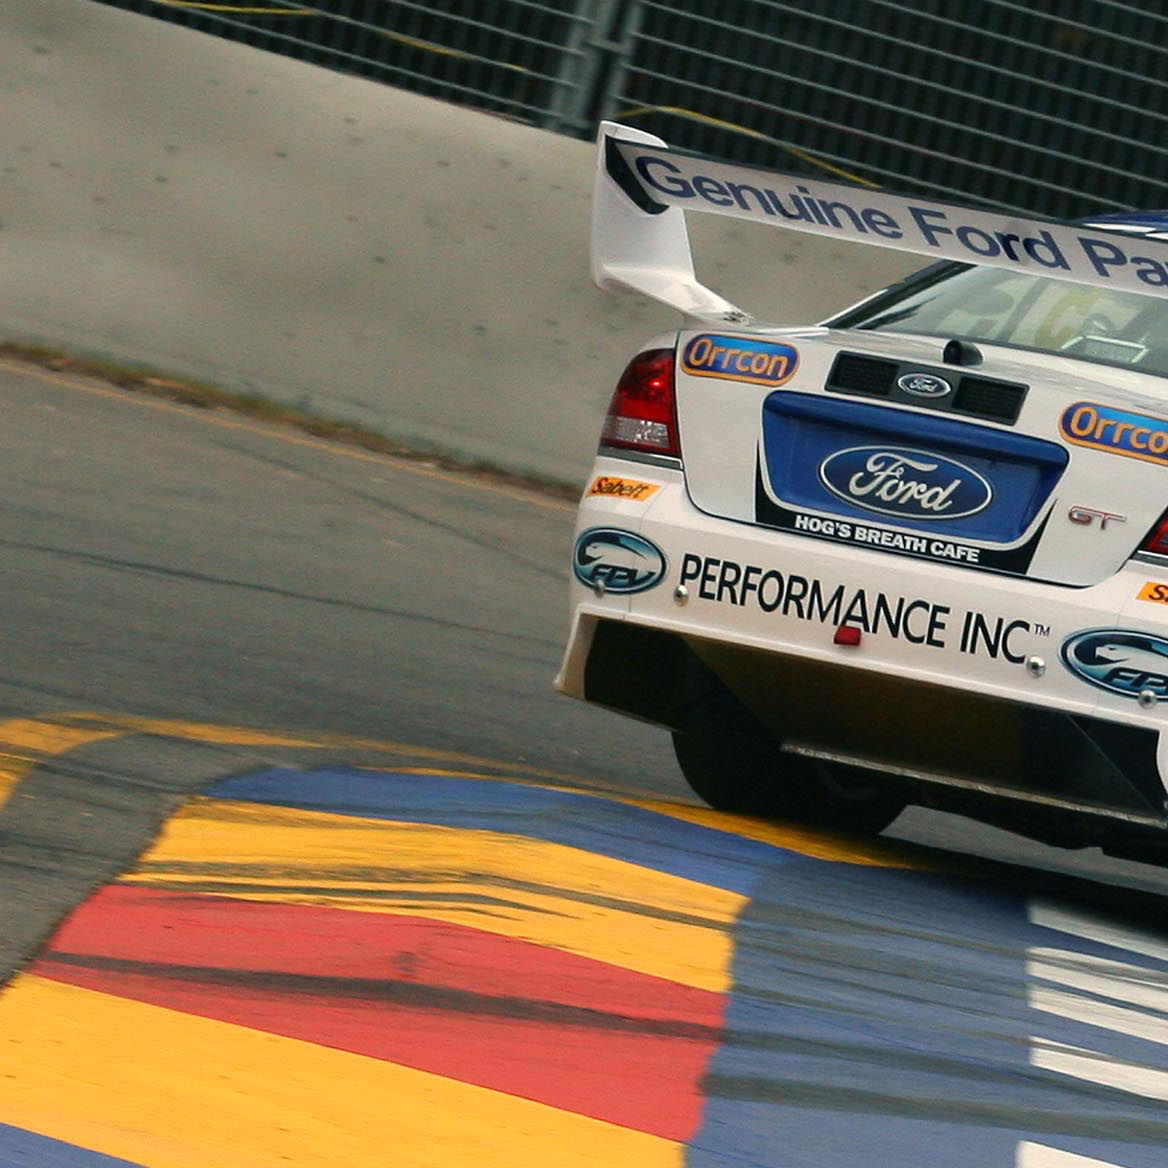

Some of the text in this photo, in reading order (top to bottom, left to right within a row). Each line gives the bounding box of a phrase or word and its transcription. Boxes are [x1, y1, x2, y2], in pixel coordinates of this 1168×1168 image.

[635, 156, 904, 240] Genuine
[908, 206, 1071, 271] Ford
[689, 338, 788, 378] Orrcon
[848, 451, 962, 512] Ford
[794, 514, 980, 563] HOG'S BREATH CAFE
[1067, 504, 1127, 530] GT
[680, 552, 951, 648] PERFORMANCE
